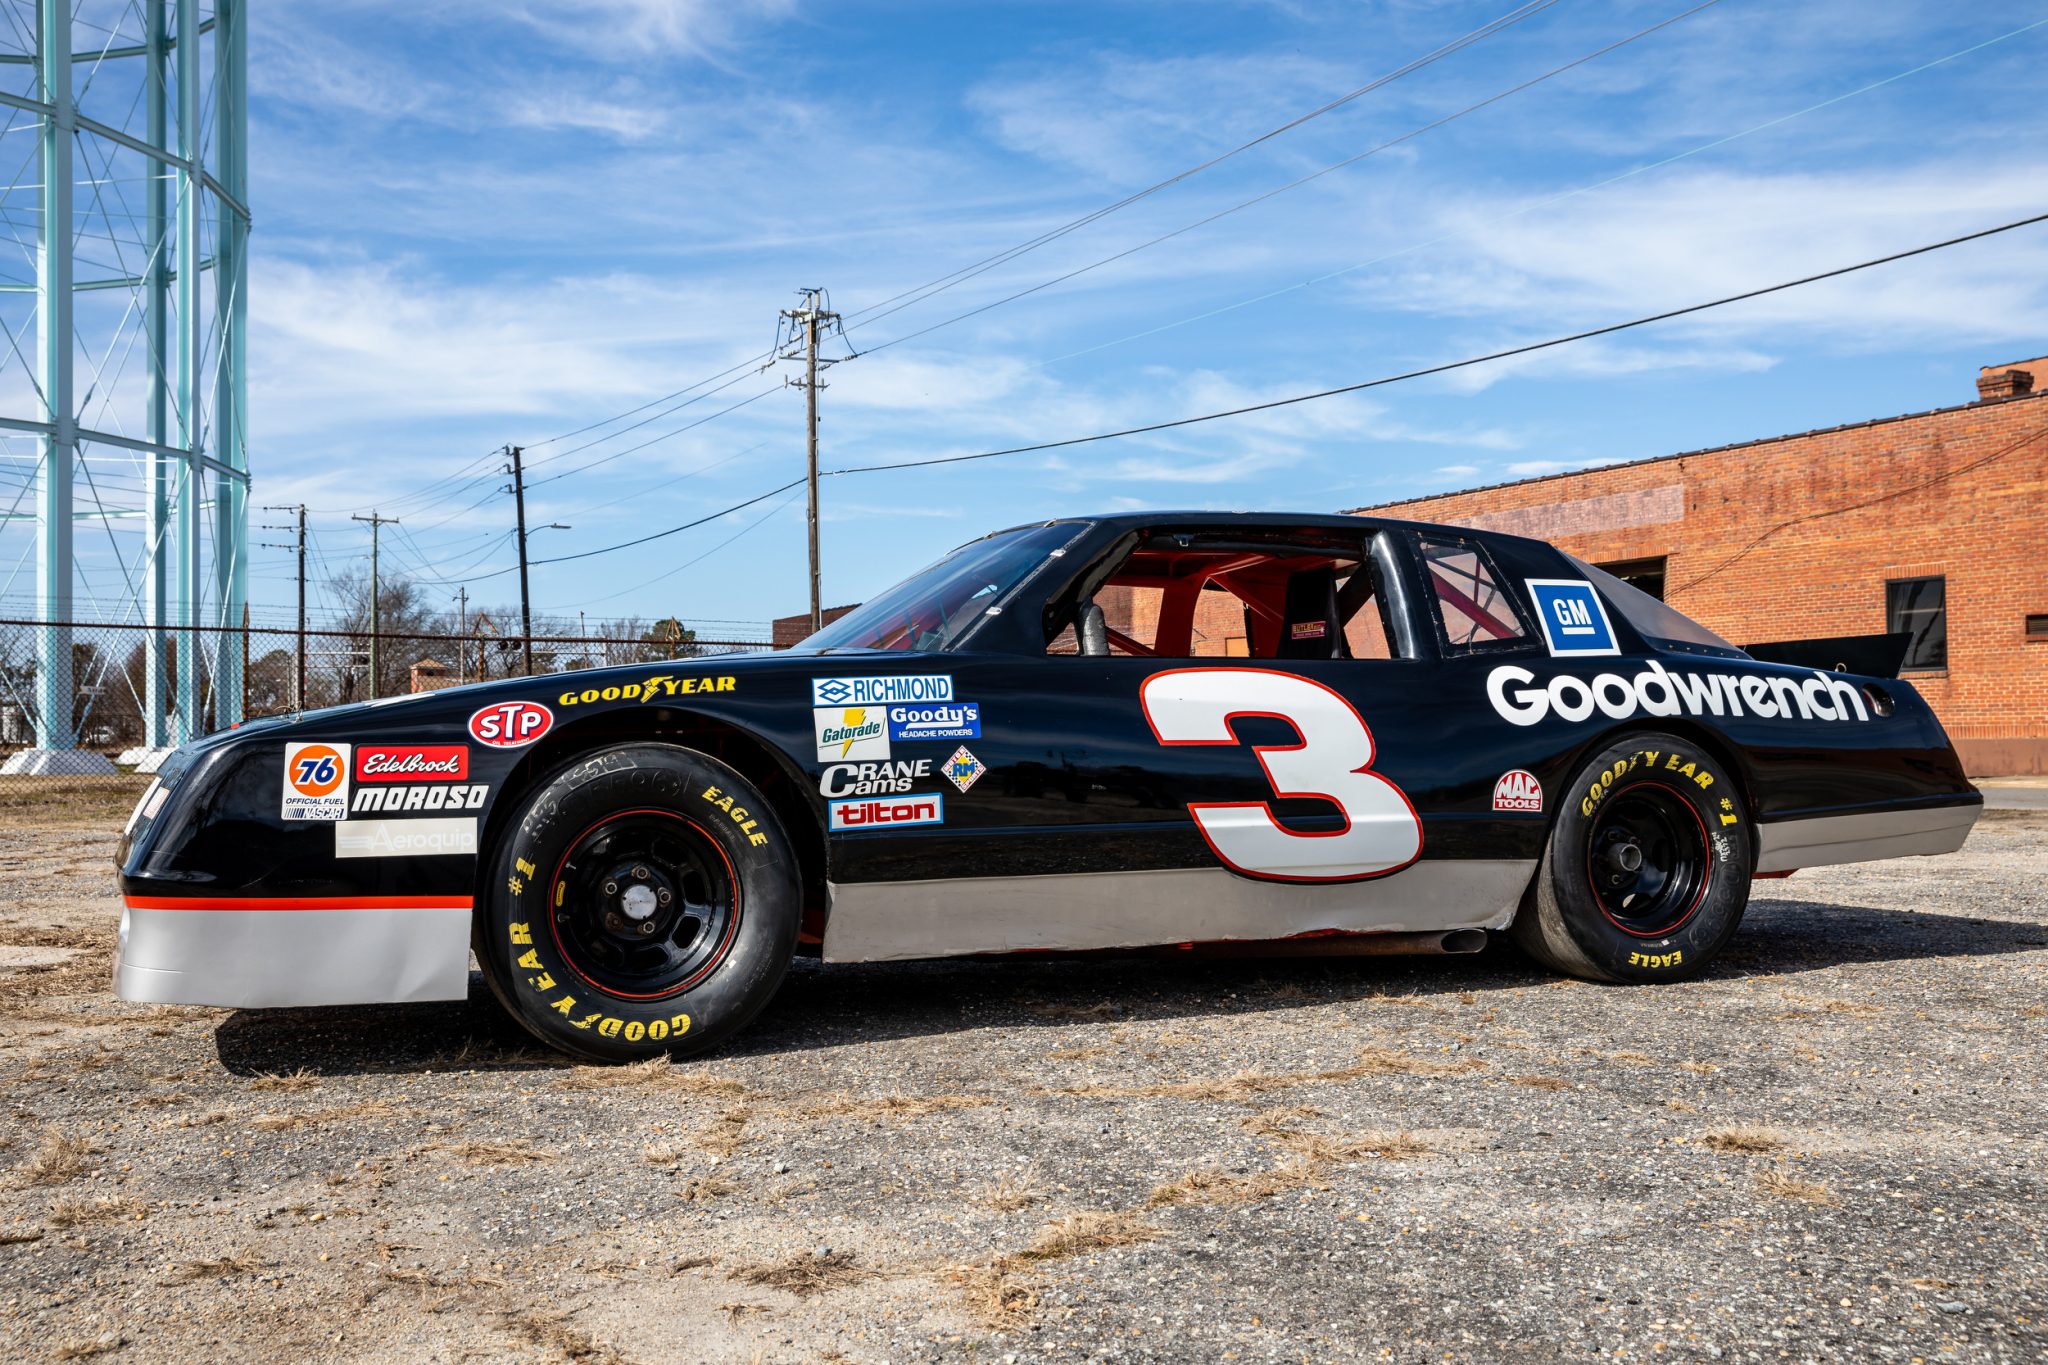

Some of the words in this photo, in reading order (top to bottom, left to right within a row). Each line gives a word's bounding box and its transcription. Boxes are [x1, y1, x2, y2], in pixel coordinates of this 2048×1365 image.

[1552, 598, 1592, 625] GM
[853, 678, 949, 702] RICHMOND
[1486, 659, 1869, 726] Goodwrench
[479, 705, 542, 739] STP
[890, 705, 977, 729] Goody's
[822, 722, 880, 743] Gatorade
[899, 730, 937, 738] HEADACHE
[938, 728, 973, 737] POWDERS
[295, 755, 338, 786] 76
[363, 753, 460, 775] Edelbrock
[1139, 667, 1424, 883] 3
[351, 785, 489, 811] MOROSO
[1496, 773, 1540, 799] MAC
[303, 808, 345, 819] NASCAR
[702, 786, 768, 847] EAGLE
[837, 803, 935, 825] tilton
[1496, 799, 1540, 809] TOOLS
[1719, 797, 1738, 826] #1
[369, 822, 473, 852] Aeroquip
[508, 857, 536, 896] #1
[1628, 950, 1682, 969] EAGLE
